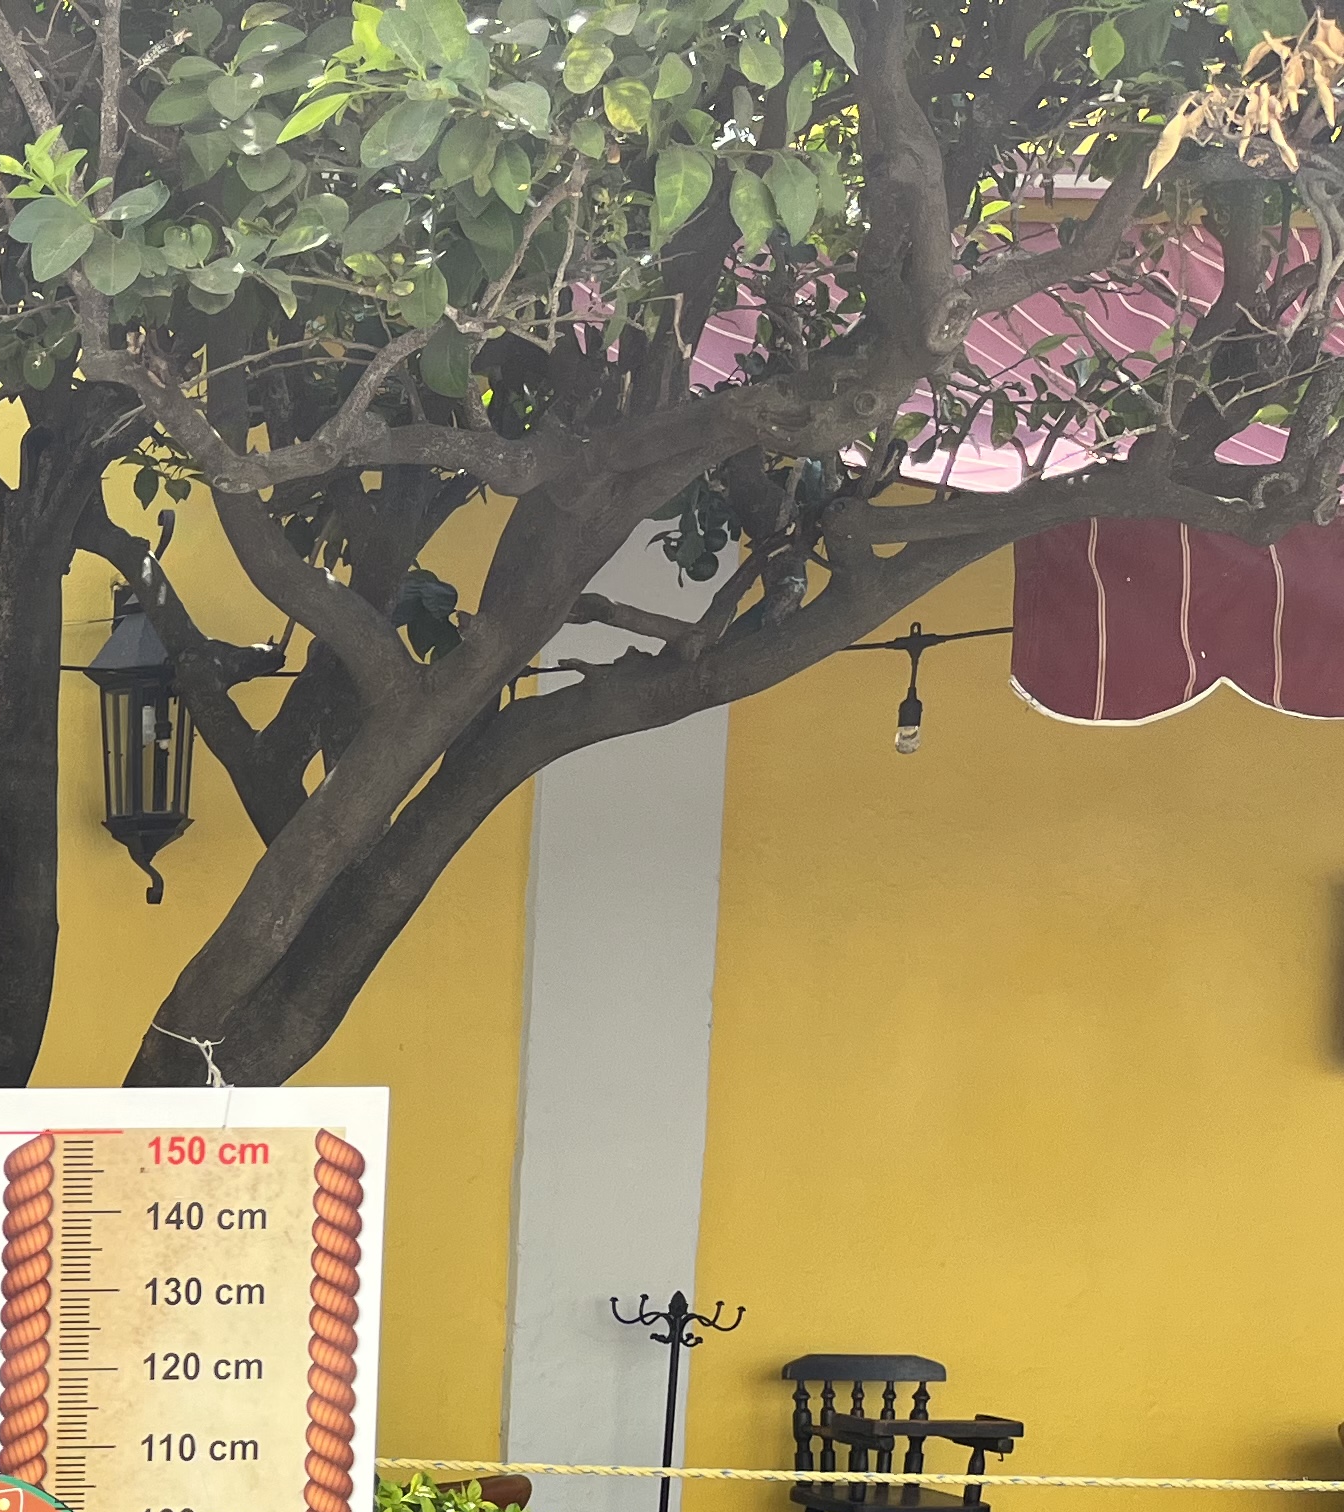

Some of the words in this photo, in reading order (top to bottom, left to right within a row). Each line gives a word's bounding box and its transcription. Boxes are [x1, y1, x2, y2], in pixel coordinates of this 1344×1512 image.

[148, 1135, 206, 1165] 150
[218, 1142, 269, 1165] cm
[146, 1201, 204, 1231] 140
[216, 1208, 267, 1231] cm
[144, 1276, 202, 1306] 130
[215, 1283, 265, 1306] cm
[143, 1351, 201, 1381] 120
[213, 1358, 263, 1381] cm
[140, 1433, 196, 1462] 110
[208, 1439, 259, 1462] cm
